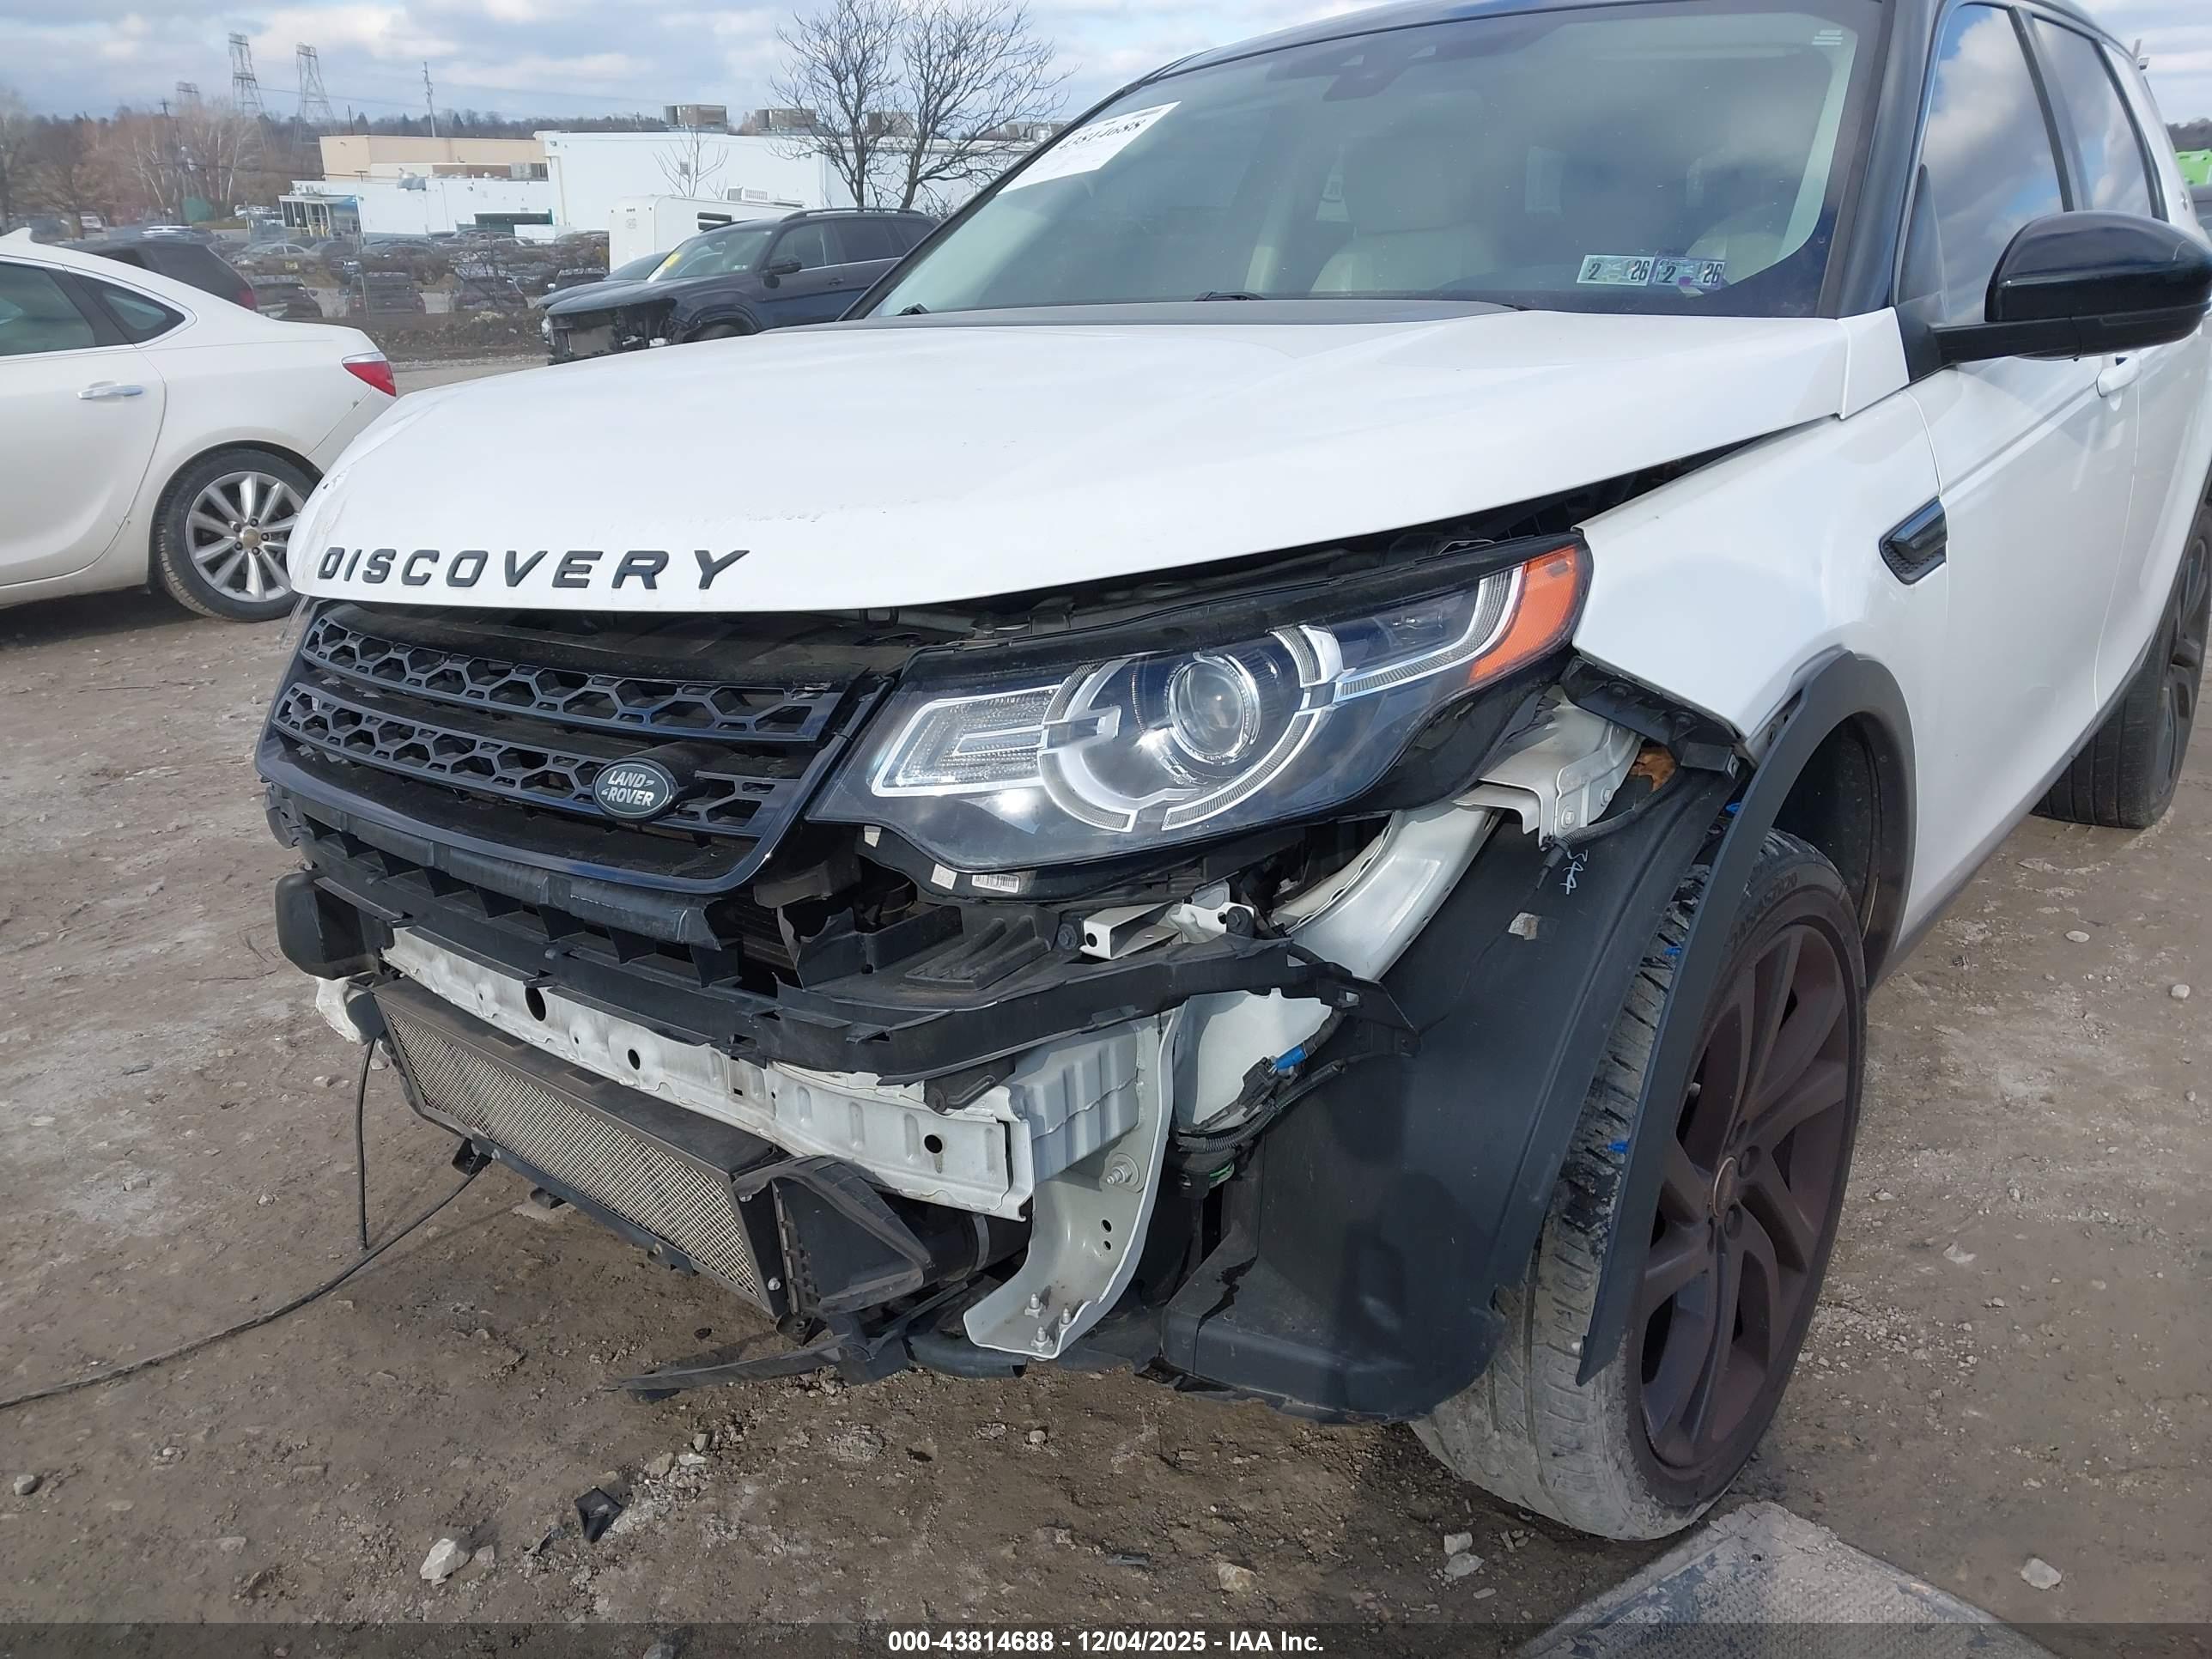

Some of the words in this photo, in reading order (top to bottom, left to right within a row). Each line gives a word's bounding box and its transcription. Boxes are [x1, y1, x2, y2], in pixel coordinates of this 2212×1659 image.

[1587, 263, 1601, 280] 2
[1631, 260, 1650, 280] 26
[1662, 265, 1677, 283] 2
[1703, 263, 1723, 284] 26
[317, 546, 750, 590] DISCOVERY
[607, 770, 648, 787] LAND
[606, 787, 655, 807] ROVER
